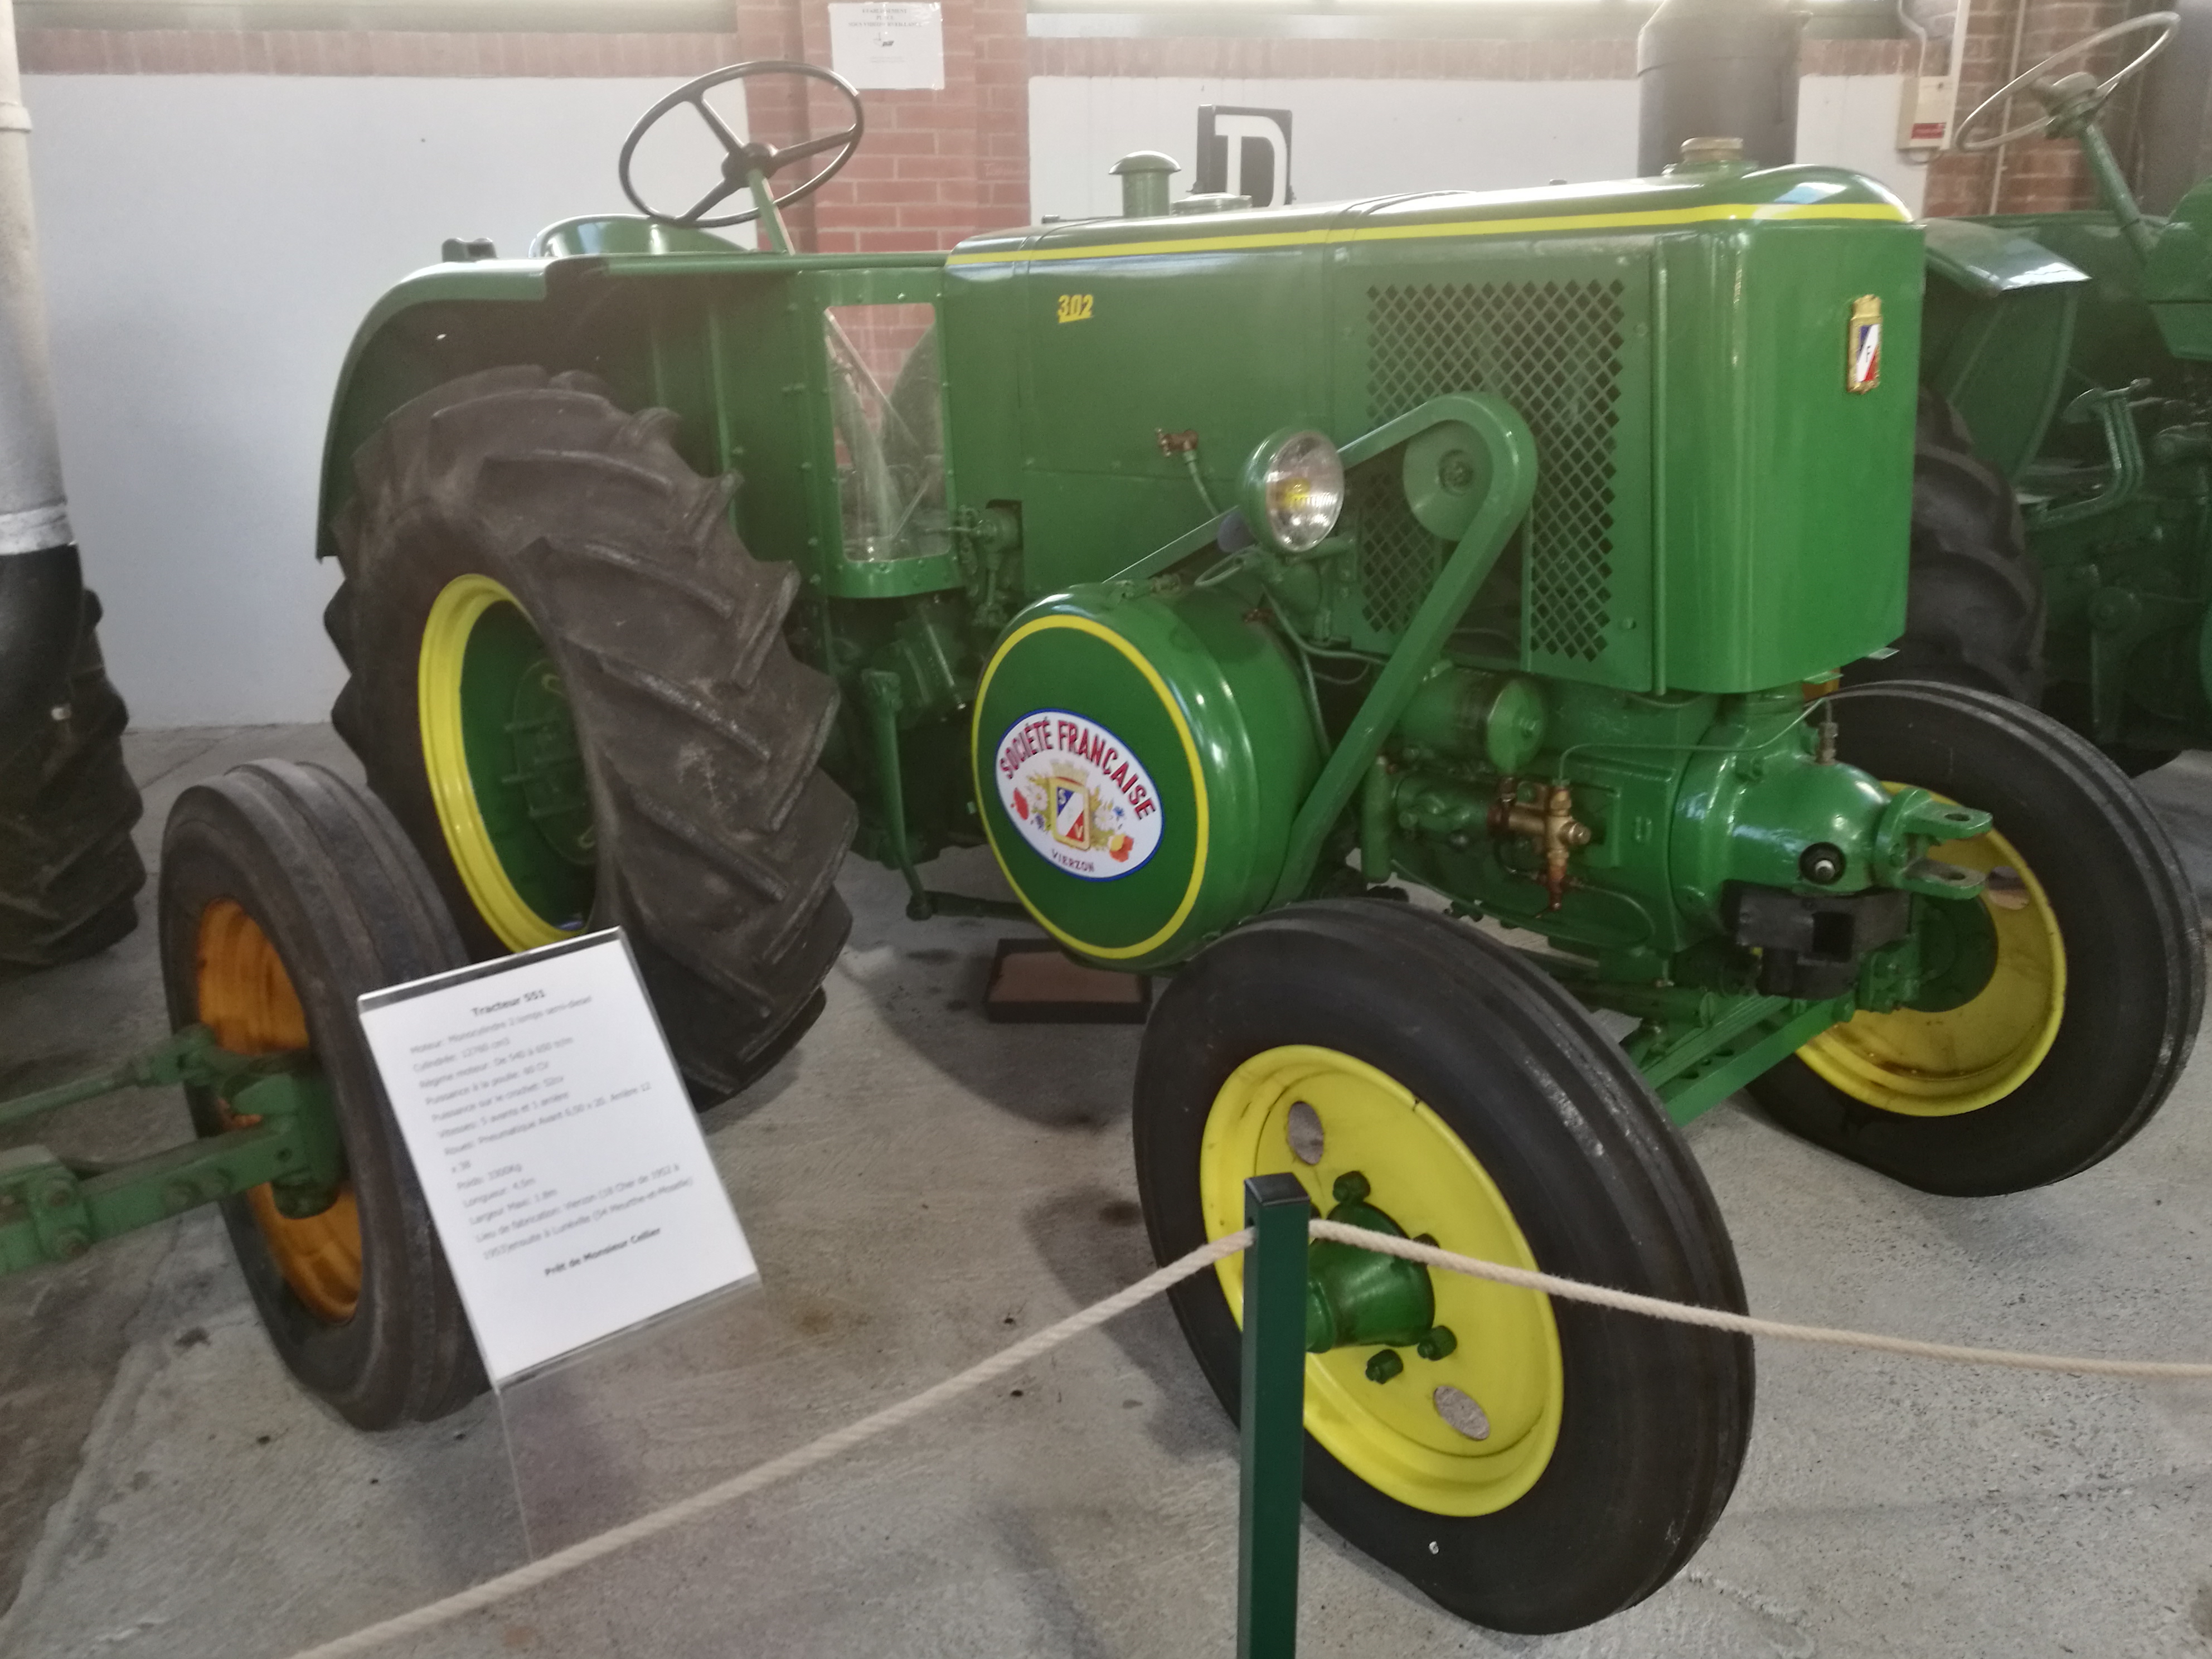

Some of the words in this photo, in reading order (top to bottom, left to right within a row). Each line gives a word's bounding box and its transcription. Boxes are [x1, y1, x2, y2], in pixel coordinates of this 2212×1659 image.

[1058, 294, 1094, 323] 302
[1000, 716, 1054, 780] SOCIÉTÉ
[1057, 719, 1157, 821] FRANÇAISE
[1051, 848, 1095, 872] VIERZON
[471, 997, 520, 1016] Tracteur
[523, 989, 545, 1002] 551
[544, 1263, 565, 1275] Prêt
[569, 1258, 581, 1267] de
[583, 1240, 627, 1260] Monsieur
